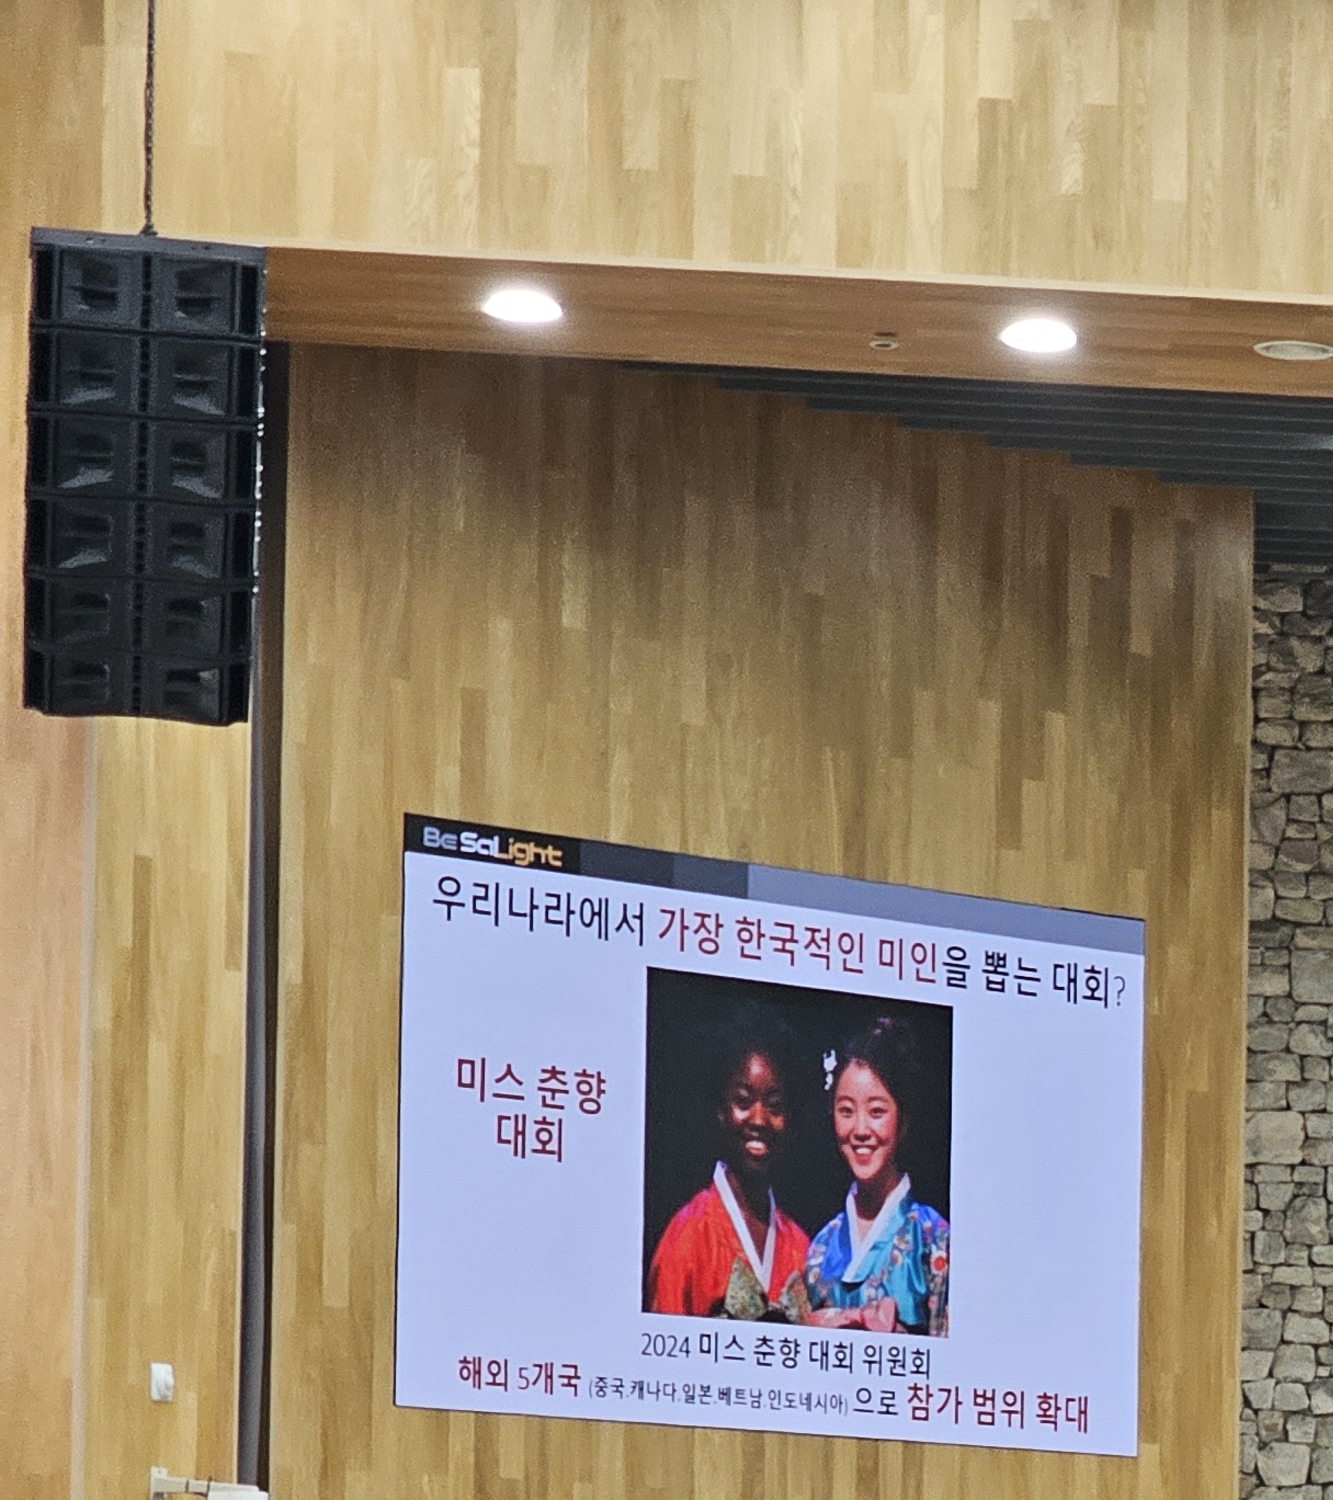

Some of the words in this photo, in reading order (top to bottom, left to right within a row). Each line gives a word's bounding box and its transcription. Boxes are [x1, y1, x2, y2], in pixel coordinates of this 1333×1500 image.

[433, 875, 645, 947] 우리나라에서
[658, 907, 724, 956] 가장
[735, 916, 864, 975] 한국적인
[877, 937, 971, 990] 미인을
[981, 950, 1041, 998] 뽑는
[1052, 962, 1126, 1009] 대회?
[457, 1057, 526, 1103] 미스
[536, 1065, 607, 1115] 춘향
[497, 1113, 563, 1163] 대회
[640, 1333, 692, 1359] 2024
[699, 1331, 747, 1363] 미스
[753, 1334, 801, 1369] 춘향
[808, 1340, 854, 1374] 대회
[862, 1344, 931, 1379] 위원회
[458, 1355, 509, 1392] 해외
[517, 1361, 582, 1397] 5개국
[852, 1387, 900, 1416] 으로
[906, 1383, 964, 1424] 참가
[972, 1387, 1025, 1430] 범위
[1034, 1391, 1089, 1434] 확대
